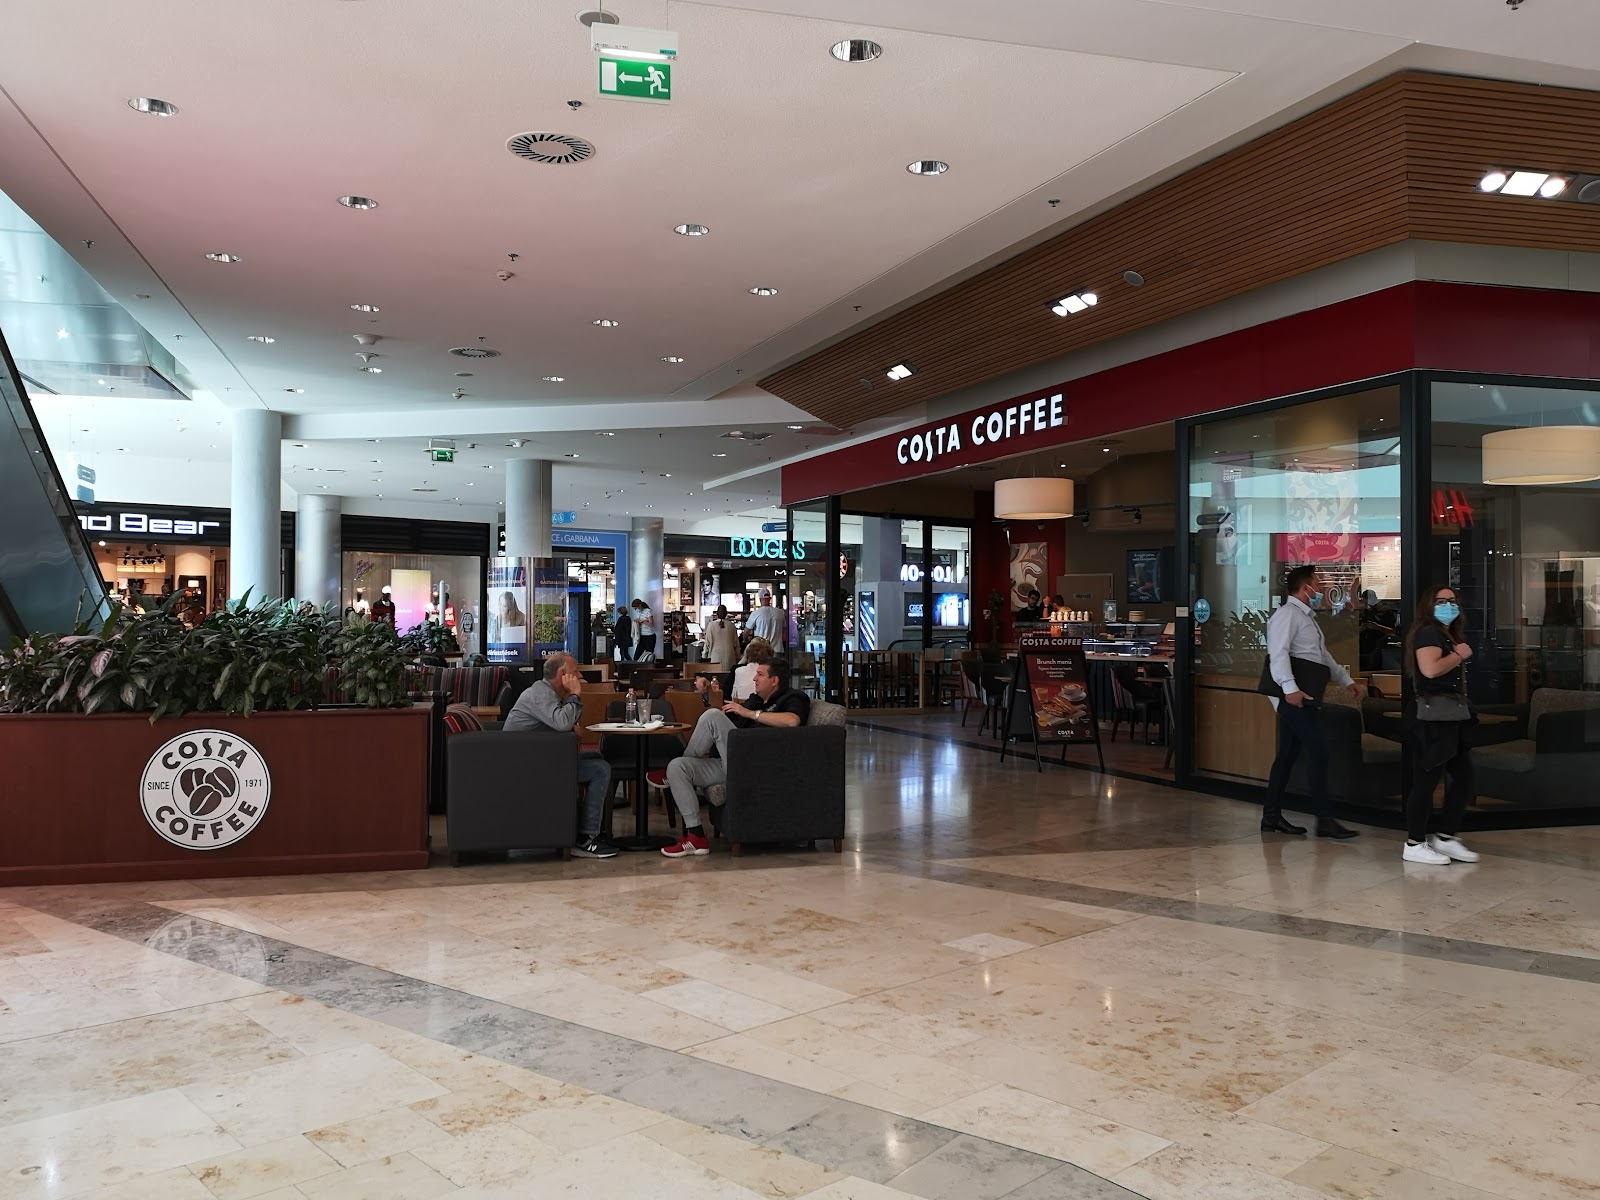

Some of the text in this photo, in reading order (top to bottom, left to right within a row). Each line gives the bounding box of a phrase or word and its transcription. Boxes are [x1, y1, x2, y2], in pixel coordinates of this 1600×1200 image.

[897, 394, 1063, 464] COSTA COFFEE
[120, 513, 220, 534] Bear
[564, 534, 600, 544] GABBANA
[774, 568, 806, 577] MC
[1021, 638, 1081, 647] COSTA COFFEE
[161, 737, 248, 770] COSTA
[147, 781, 170, 791] SINCE
[244, 778, 263, 788] 1971
[155, 800, 259, 841] COFFEE
